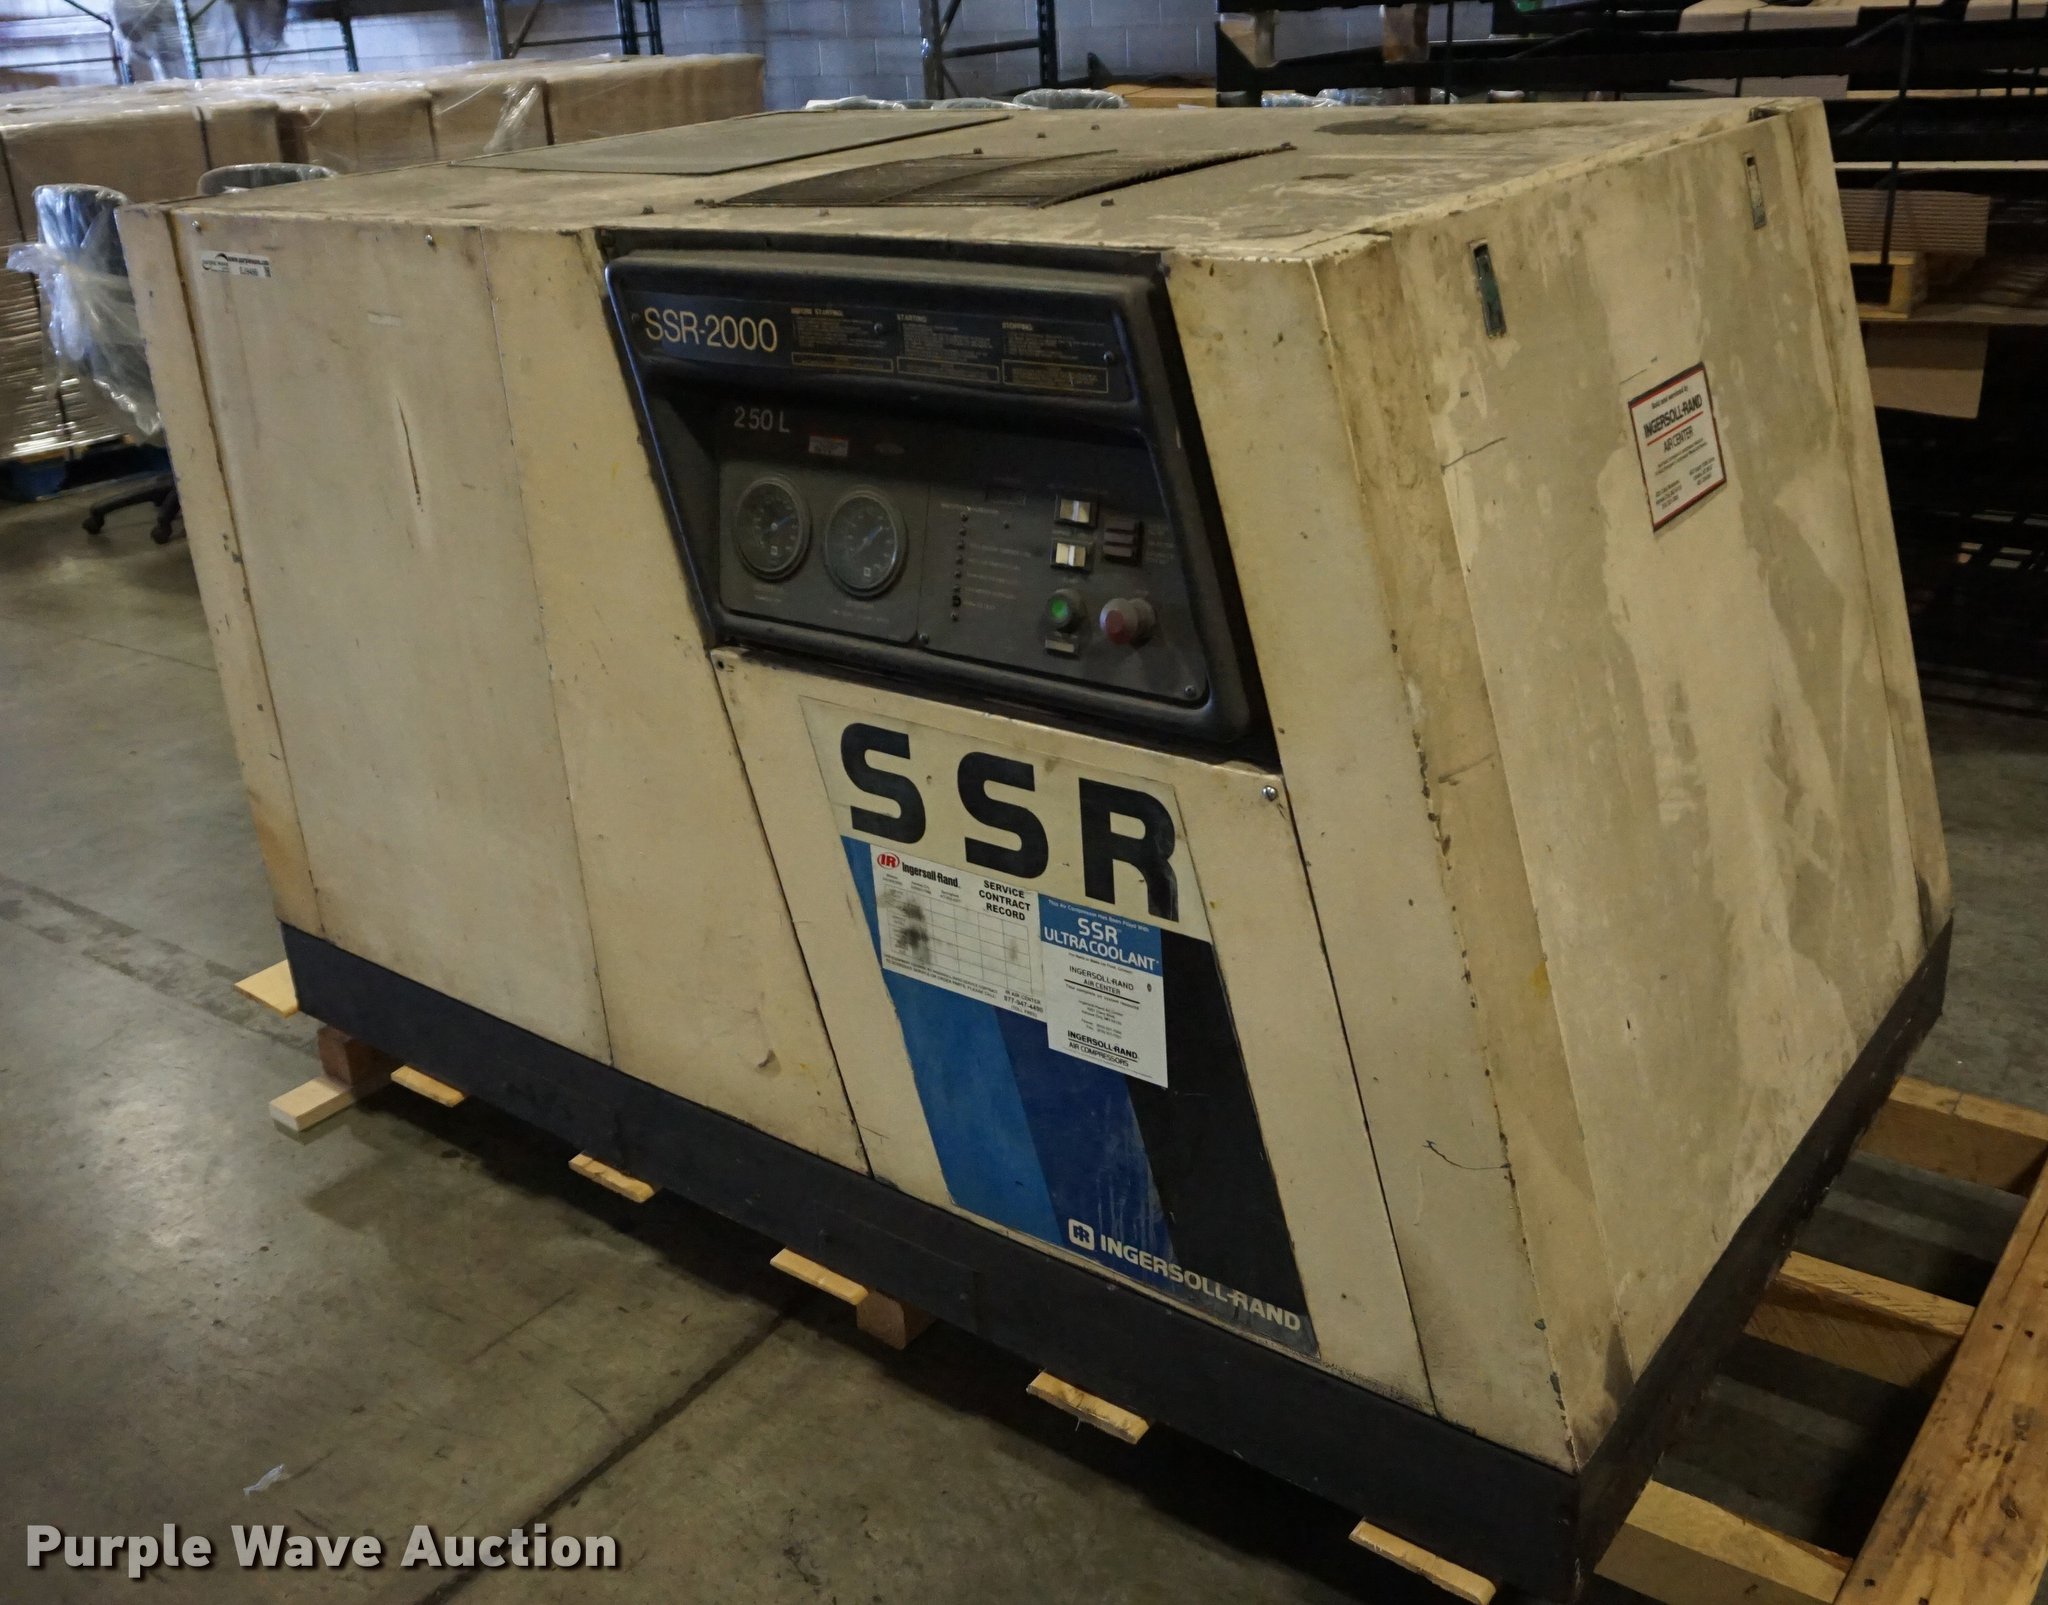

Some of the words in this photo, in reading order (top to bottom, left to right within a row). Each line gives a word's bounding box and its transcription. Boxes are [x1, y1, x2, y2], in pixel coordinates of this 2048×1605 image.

[644, 307, 778, 352] SSR-2000
[733, 406, 773, 431] 250
[840, 722, 1180, 923] SSR
[978, 889, 1031, 911] CONTRACT
[983, 879, 1025, 899] SERVICE
[986, 902, 1026, 921] RECORD
[1077, 917, 1118, 945] SSR
[1069, 965, 1134, 991] INGERSOLL-RAND
[1095, 981, 1121, 995] CENTER
[1067, 1030, 1139, 1059] INGERSOLL-RAND
[1069, 1041, 1080, 1050] AIR
[1080, 1045, 1129, 1067] COMPRESSORS
[1101, 1234, 1301, 1331] INGERSOLL-RAND
